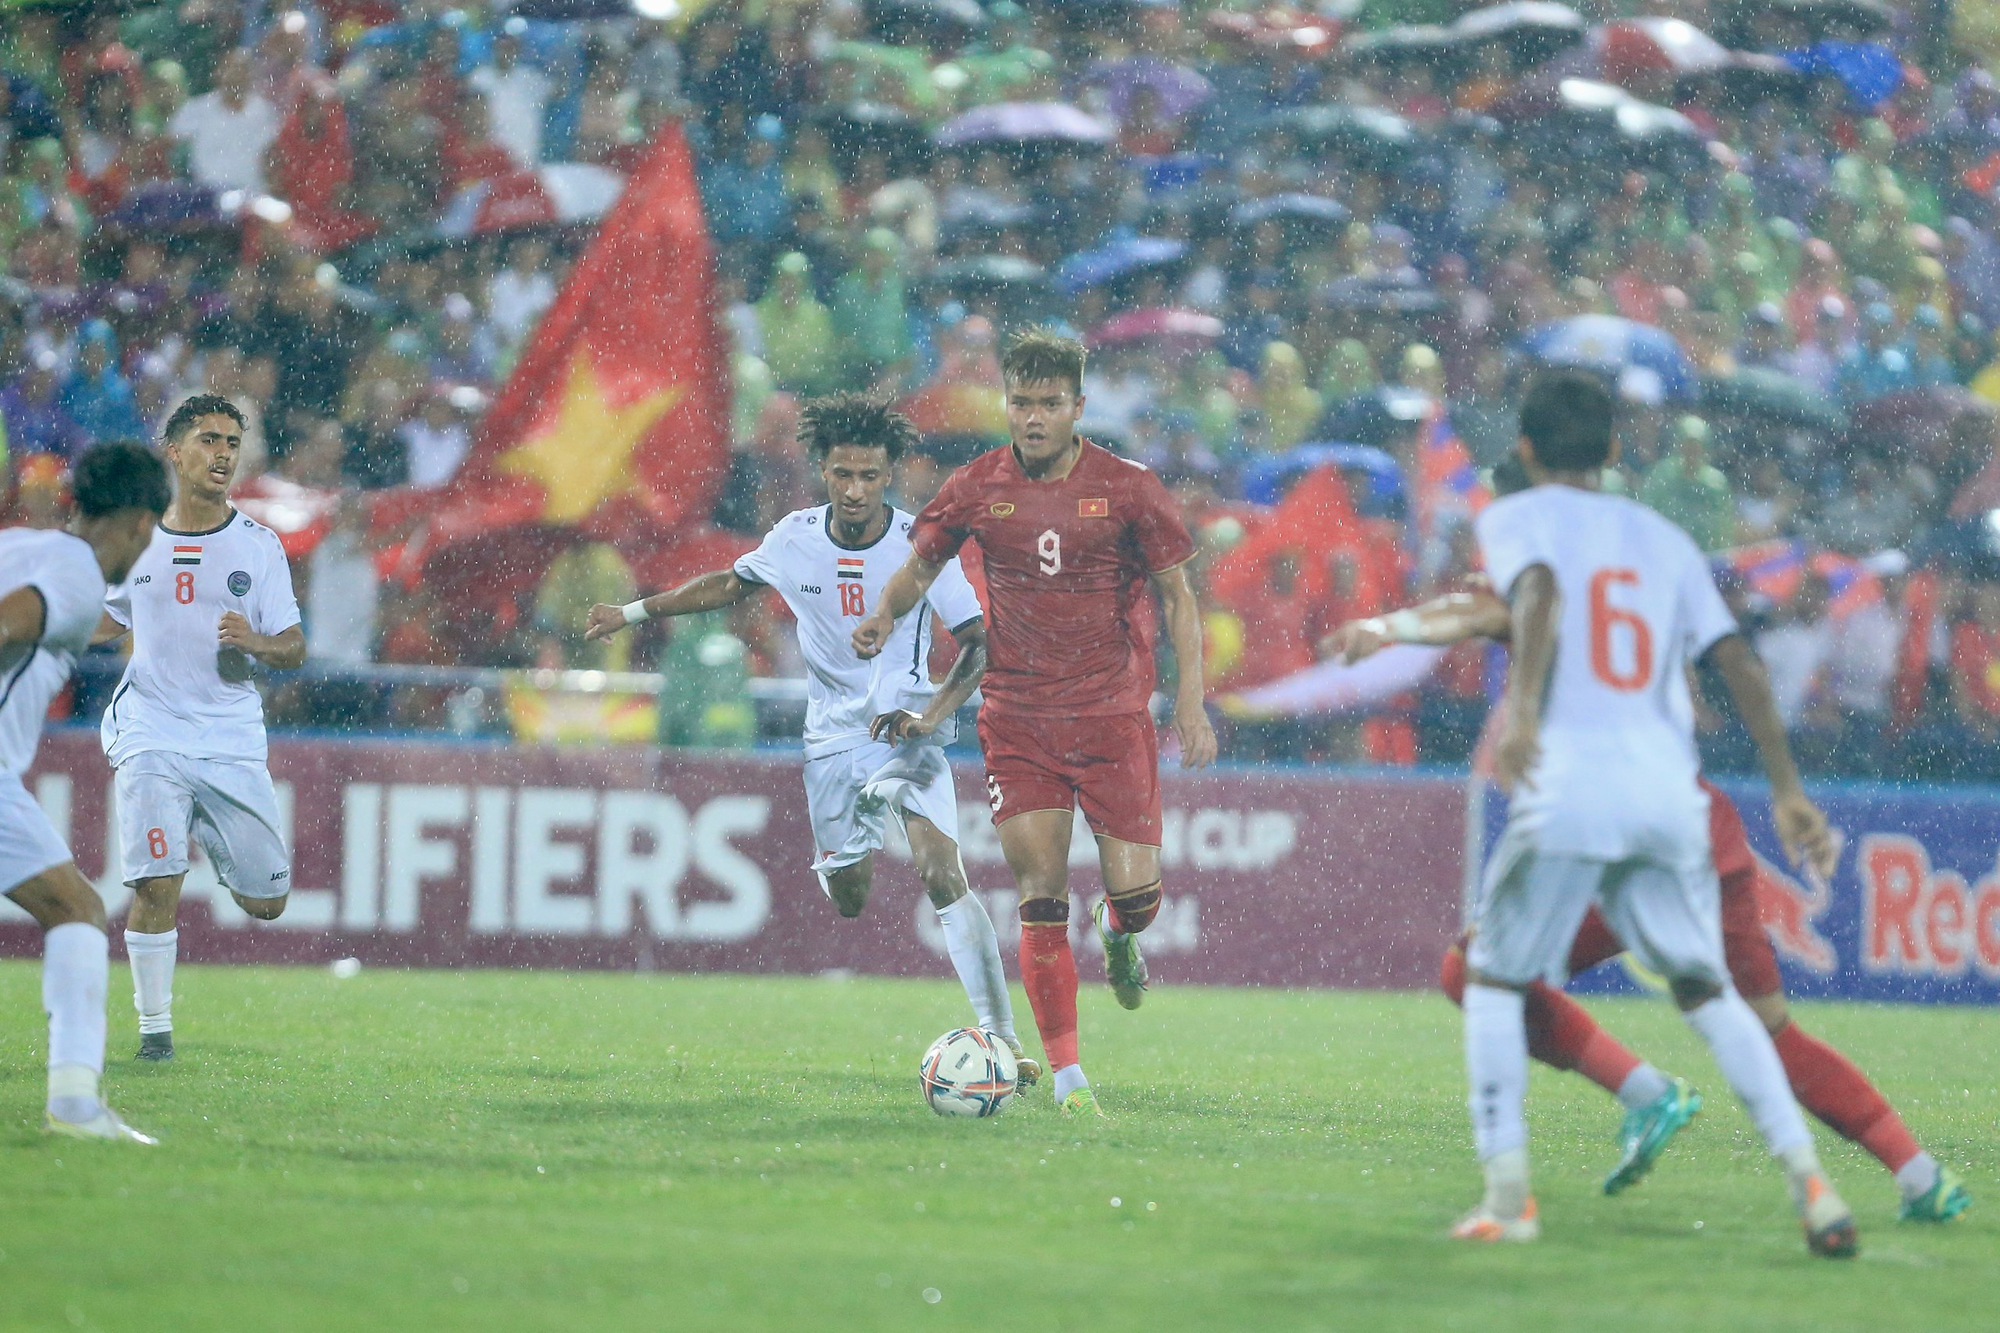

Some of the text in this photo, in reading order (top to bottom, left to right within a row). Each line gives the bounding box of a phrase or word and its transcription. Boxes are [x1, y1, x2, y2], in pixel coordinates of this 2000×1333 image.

[1038, 529, 1060, 576] 9
[176, 571, 195, 605] 8
[800, 584, 822, 595] JAKO
[837, 583, 865, 617] 18
[1589, 569, 1654, 691] 6
[147, 828, 168, 859] 8
